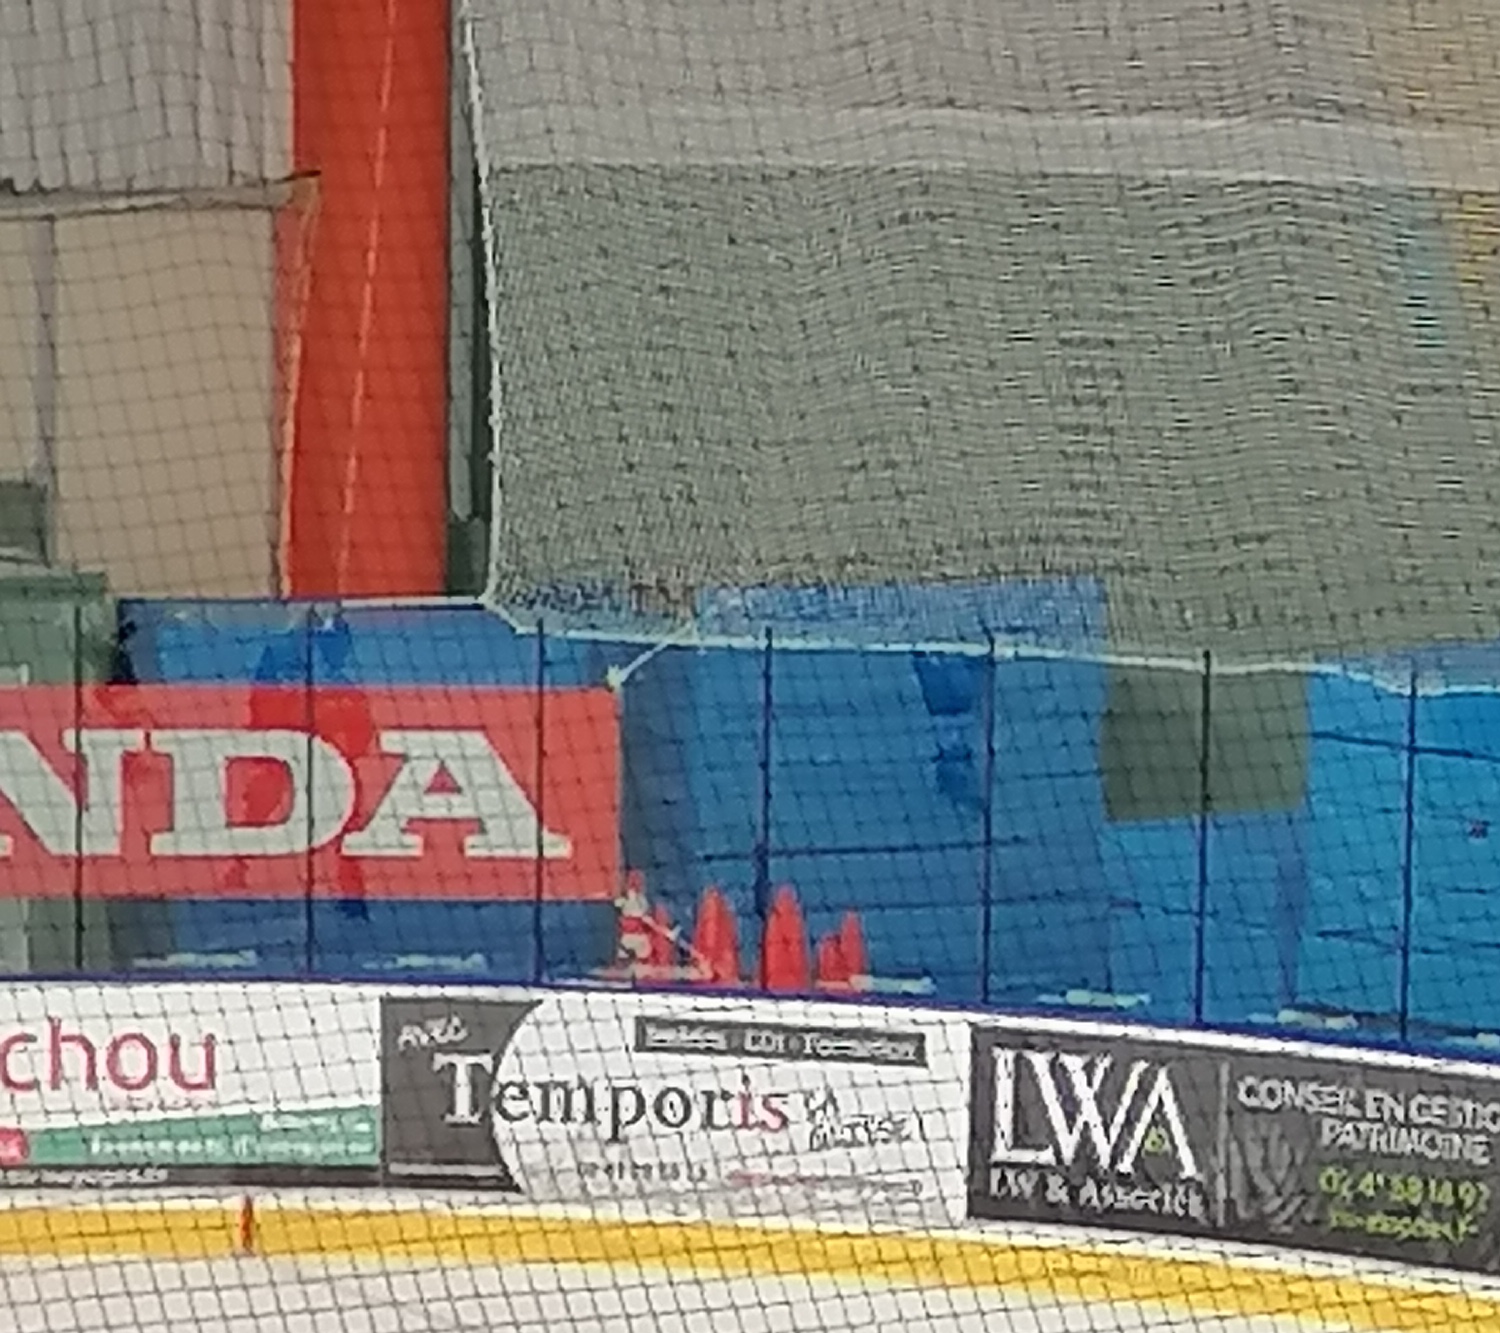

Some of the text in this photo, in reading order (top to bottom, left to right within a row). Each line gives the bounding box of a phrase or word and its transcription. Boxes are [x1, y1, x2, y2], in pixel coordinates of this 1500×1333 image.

[0, 729, 572, 857] NDA
[0, 1017, 217, 1091] chou
[431, 1052, 790, 1146] Temporis
[990, 1047, 1203, 1180] LWA
[1237, 1075, 1361, 1118] CONSEIL
[1365, 1089, 1406, 1123] EN
[1320, 1120, 1491, 1165] PATRIMOINE
